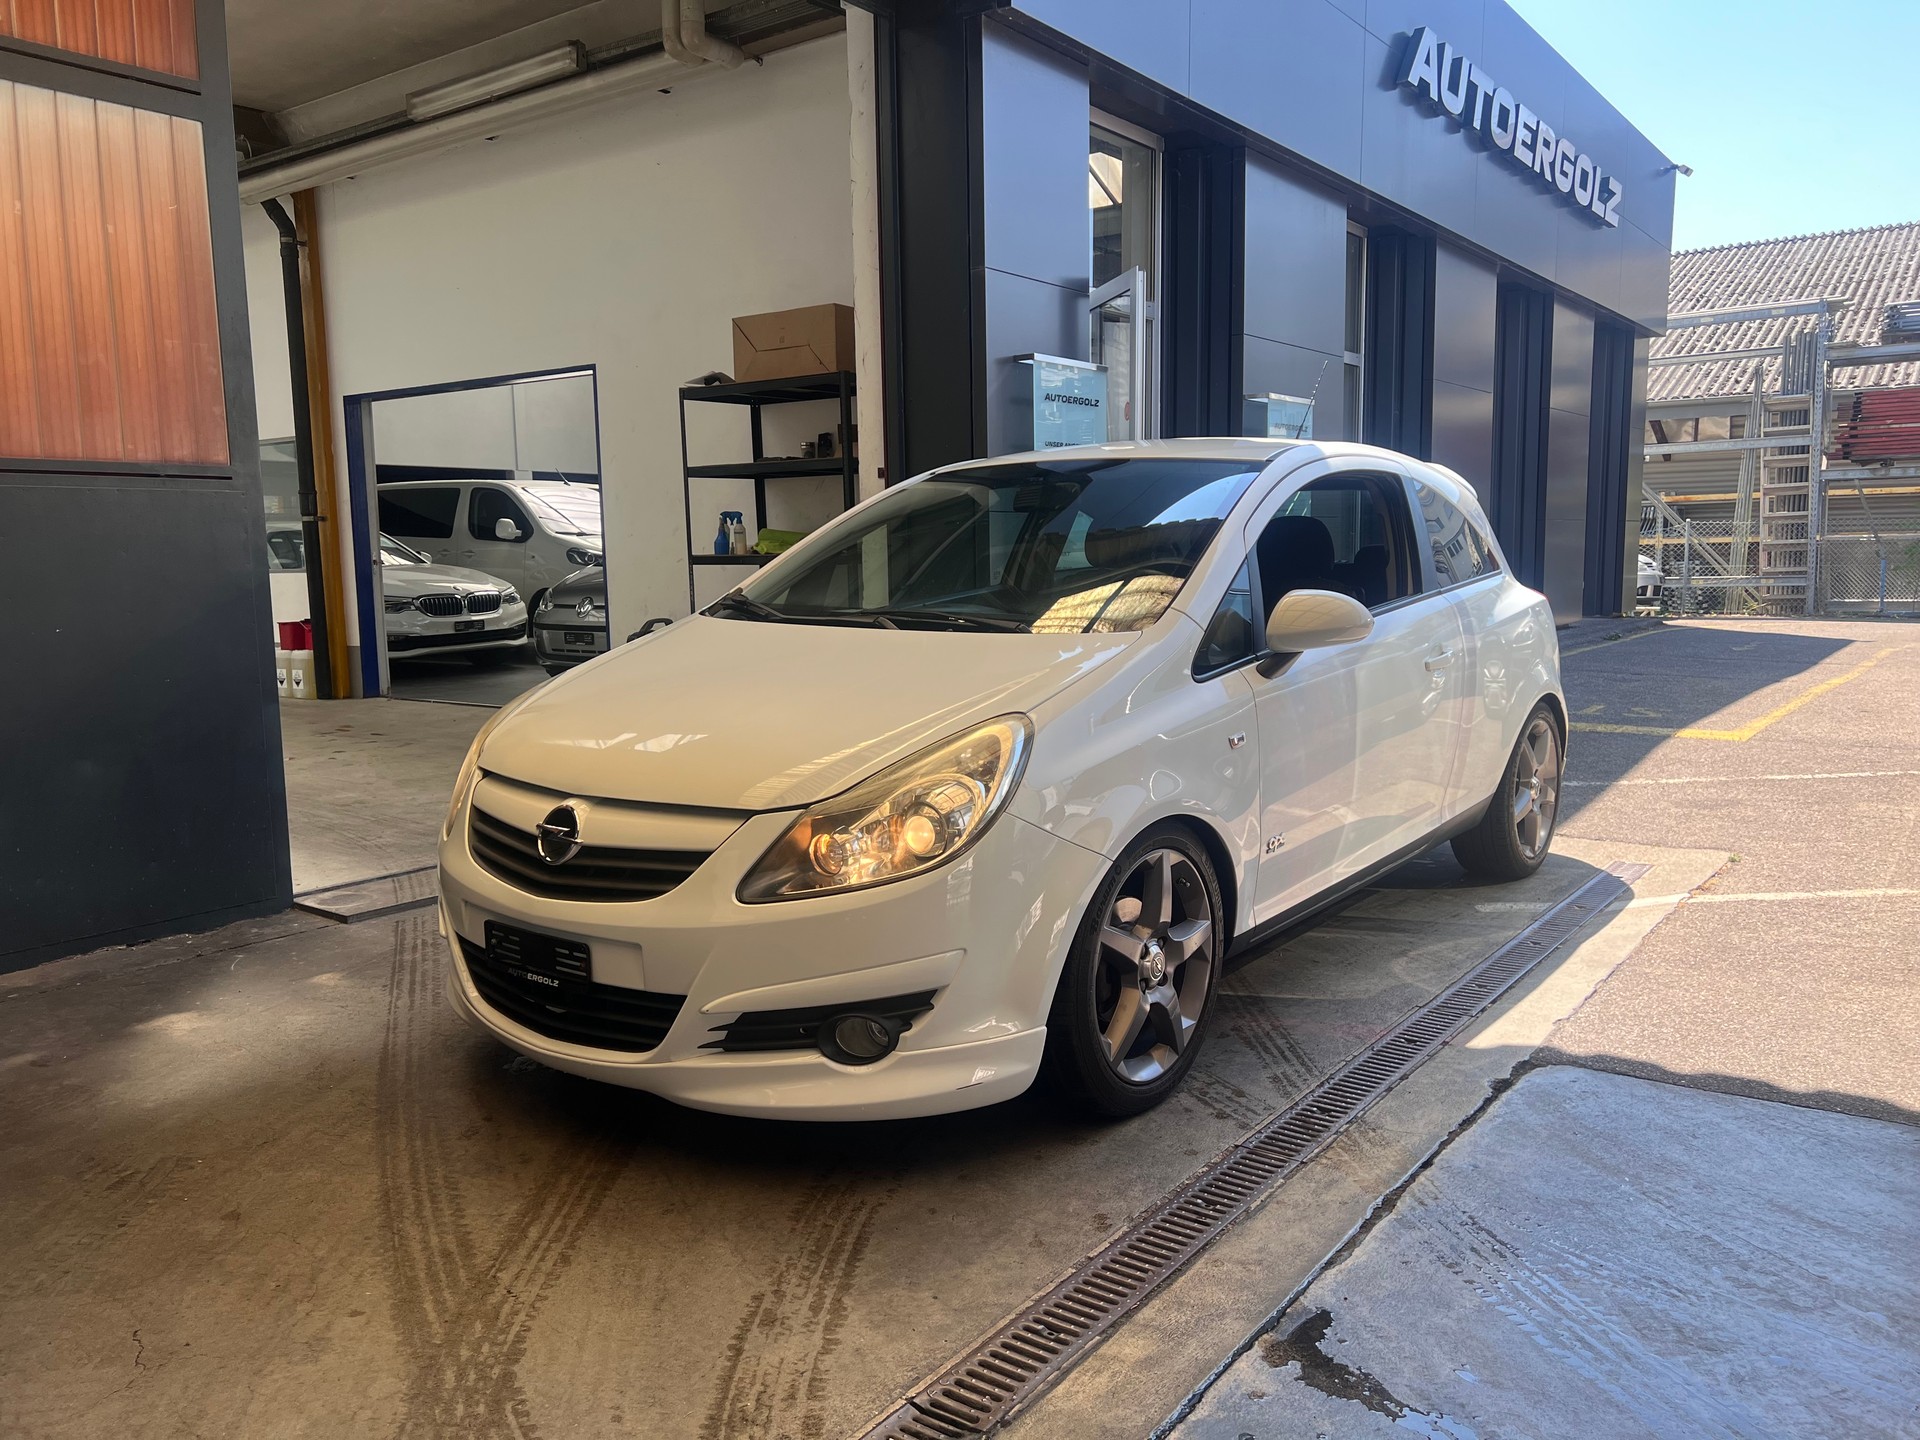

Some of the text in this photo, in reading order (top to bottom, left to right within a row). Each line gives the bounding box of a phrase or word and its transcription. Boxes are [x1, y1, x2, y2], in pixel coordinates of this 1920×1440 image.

[1400, 26, 1622, 228] AUTOERGOLZ
[1044, 393, 1100, 408] AUTOERGOLZ
[508, 967, 560, 987] AUTOERGOLZ
